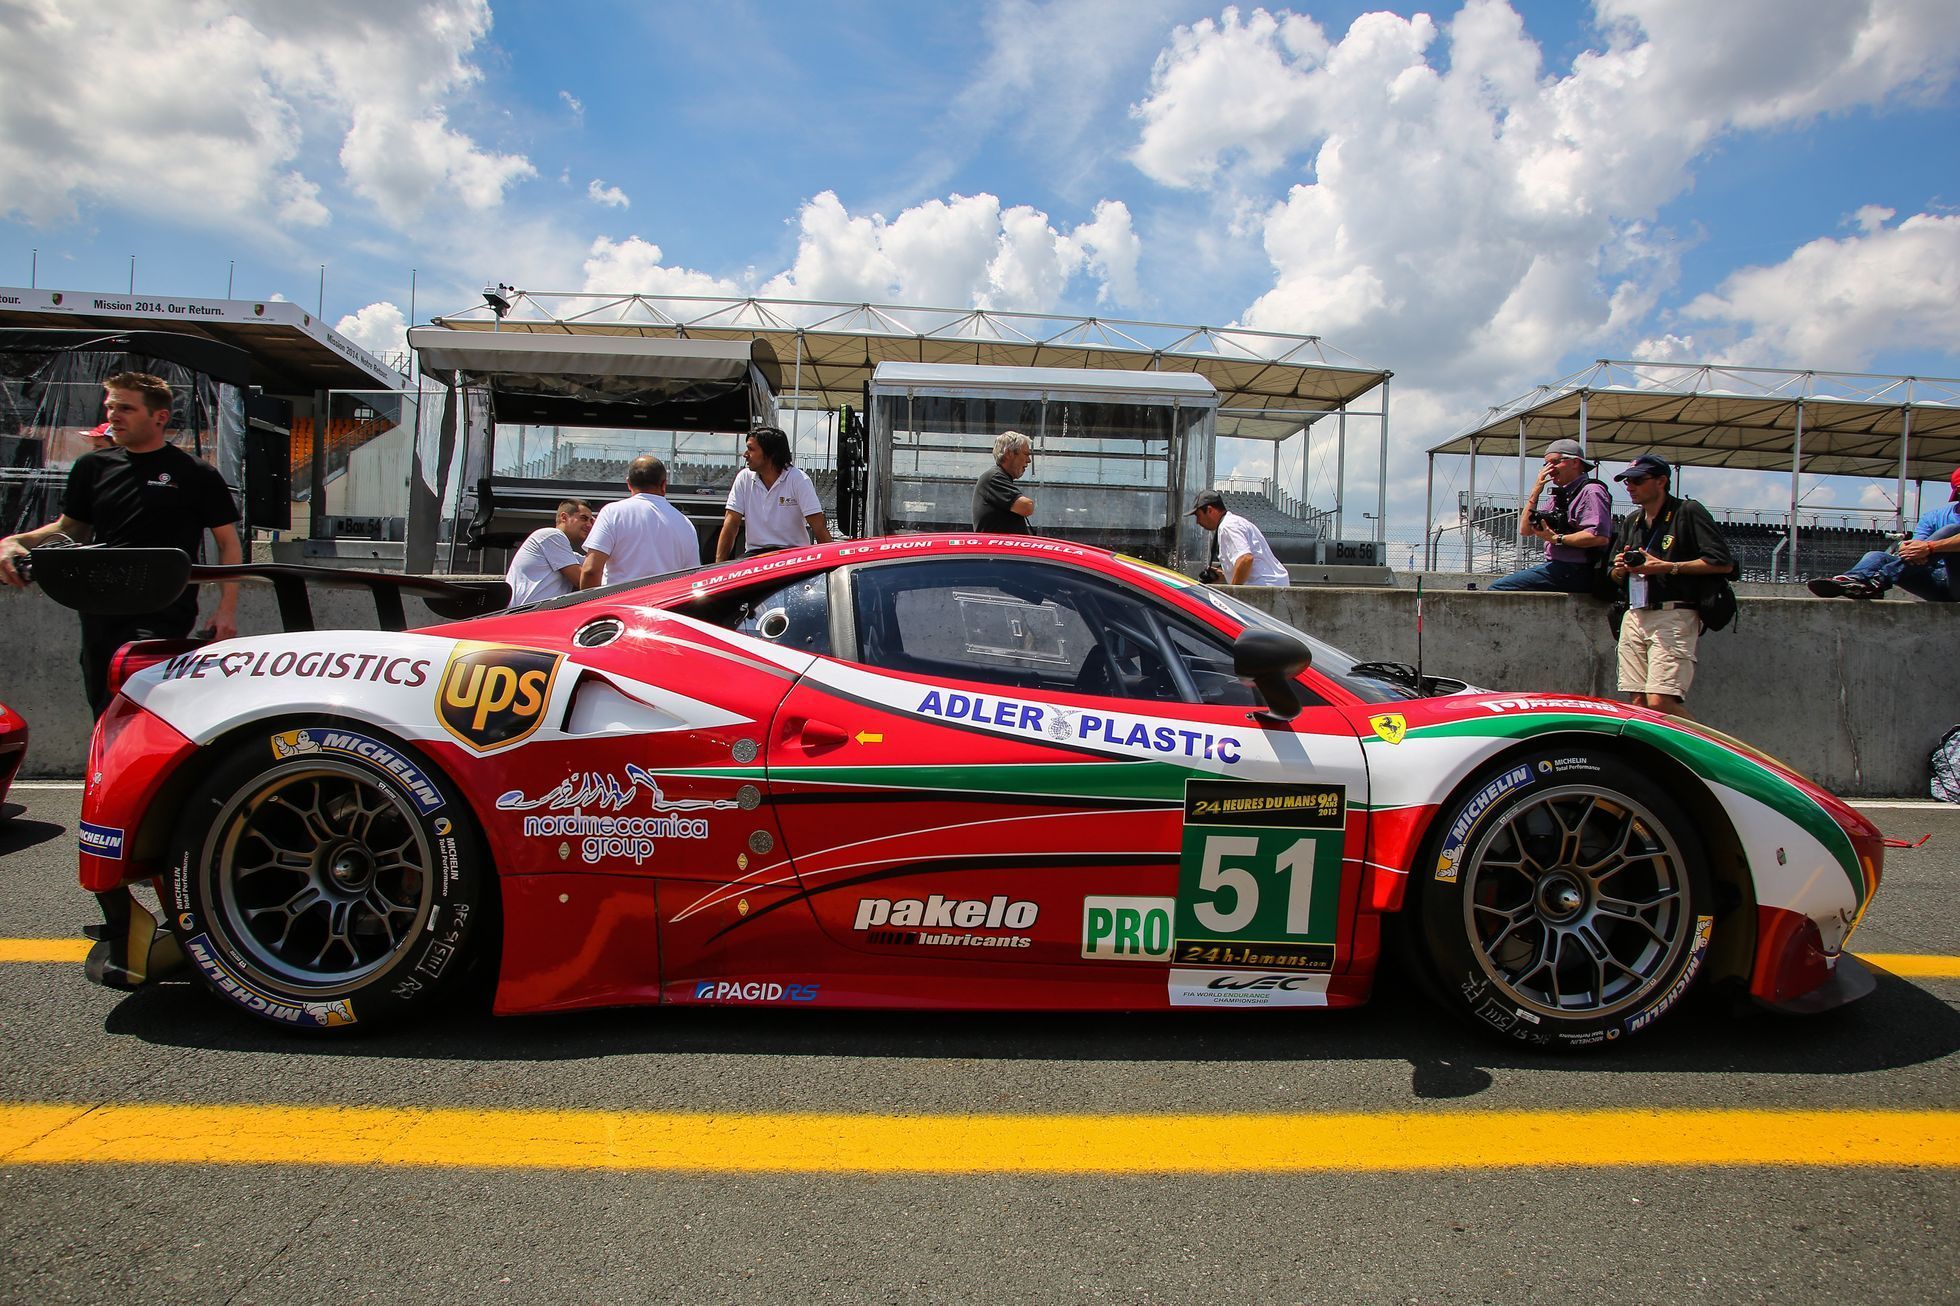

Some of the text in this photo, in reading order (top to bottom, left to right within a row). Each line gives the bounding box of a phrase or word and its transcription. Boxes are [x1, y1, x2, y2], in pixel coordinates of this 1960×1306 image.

[94, 300, 225, 316] Mission 2014. Our Return.
[327, 334, 345, 351] Mission
[345, 519, 366, 534] Box
[880, 541, 932, 550] BRUNI
[988, 540, 1085, 556] FISICHELLA
[1336, 543, 1373, 560] Box 56
[161, 651, 432, 688] WE LOGISTICS
[446, 662, 548, 731] ups
[917, 690, 1242, 764] ADLER PLASTIC
[323, 733, 440, 806] MICHELIN
[1554, 758, 1588, 766] MICHELIN
[1192, 801, 1222, 816] 24
[1222, 798, 1264, 811] HEURES
[1265, 796, 1282, 808] DU
[1283, 794, 1317, 807] MANS
[1318, 808, 1338, 816] 2013
[1452, 768, 1528, 842] MICHELIN
[524, 807, 708, 838] nordmeccanica
[438, 838, 446, 853] Total
[446, 838, 459, 880] MICHELIN
[582, 836, 654, 864] group
[174, 866, 184, 910] MICHELIN
[182, 850, 191, 910] Total Performance
[1193, 835, 1318, 936] 51
[853, 895, 1040, 930] pakelo
[918, 932, 1032, 948] lubricants
[1086, 908, 1170, 956] PRO
[190, 944, 302, 1022] MICHELIN
[716, 982, 821, 1001] PAGID RS
[1207, 976, 1310, 990] WEC
[1631, 956, 1700, 1032] MICHELIN
[1570, 1037, 1604, 1046] MICHELIN
